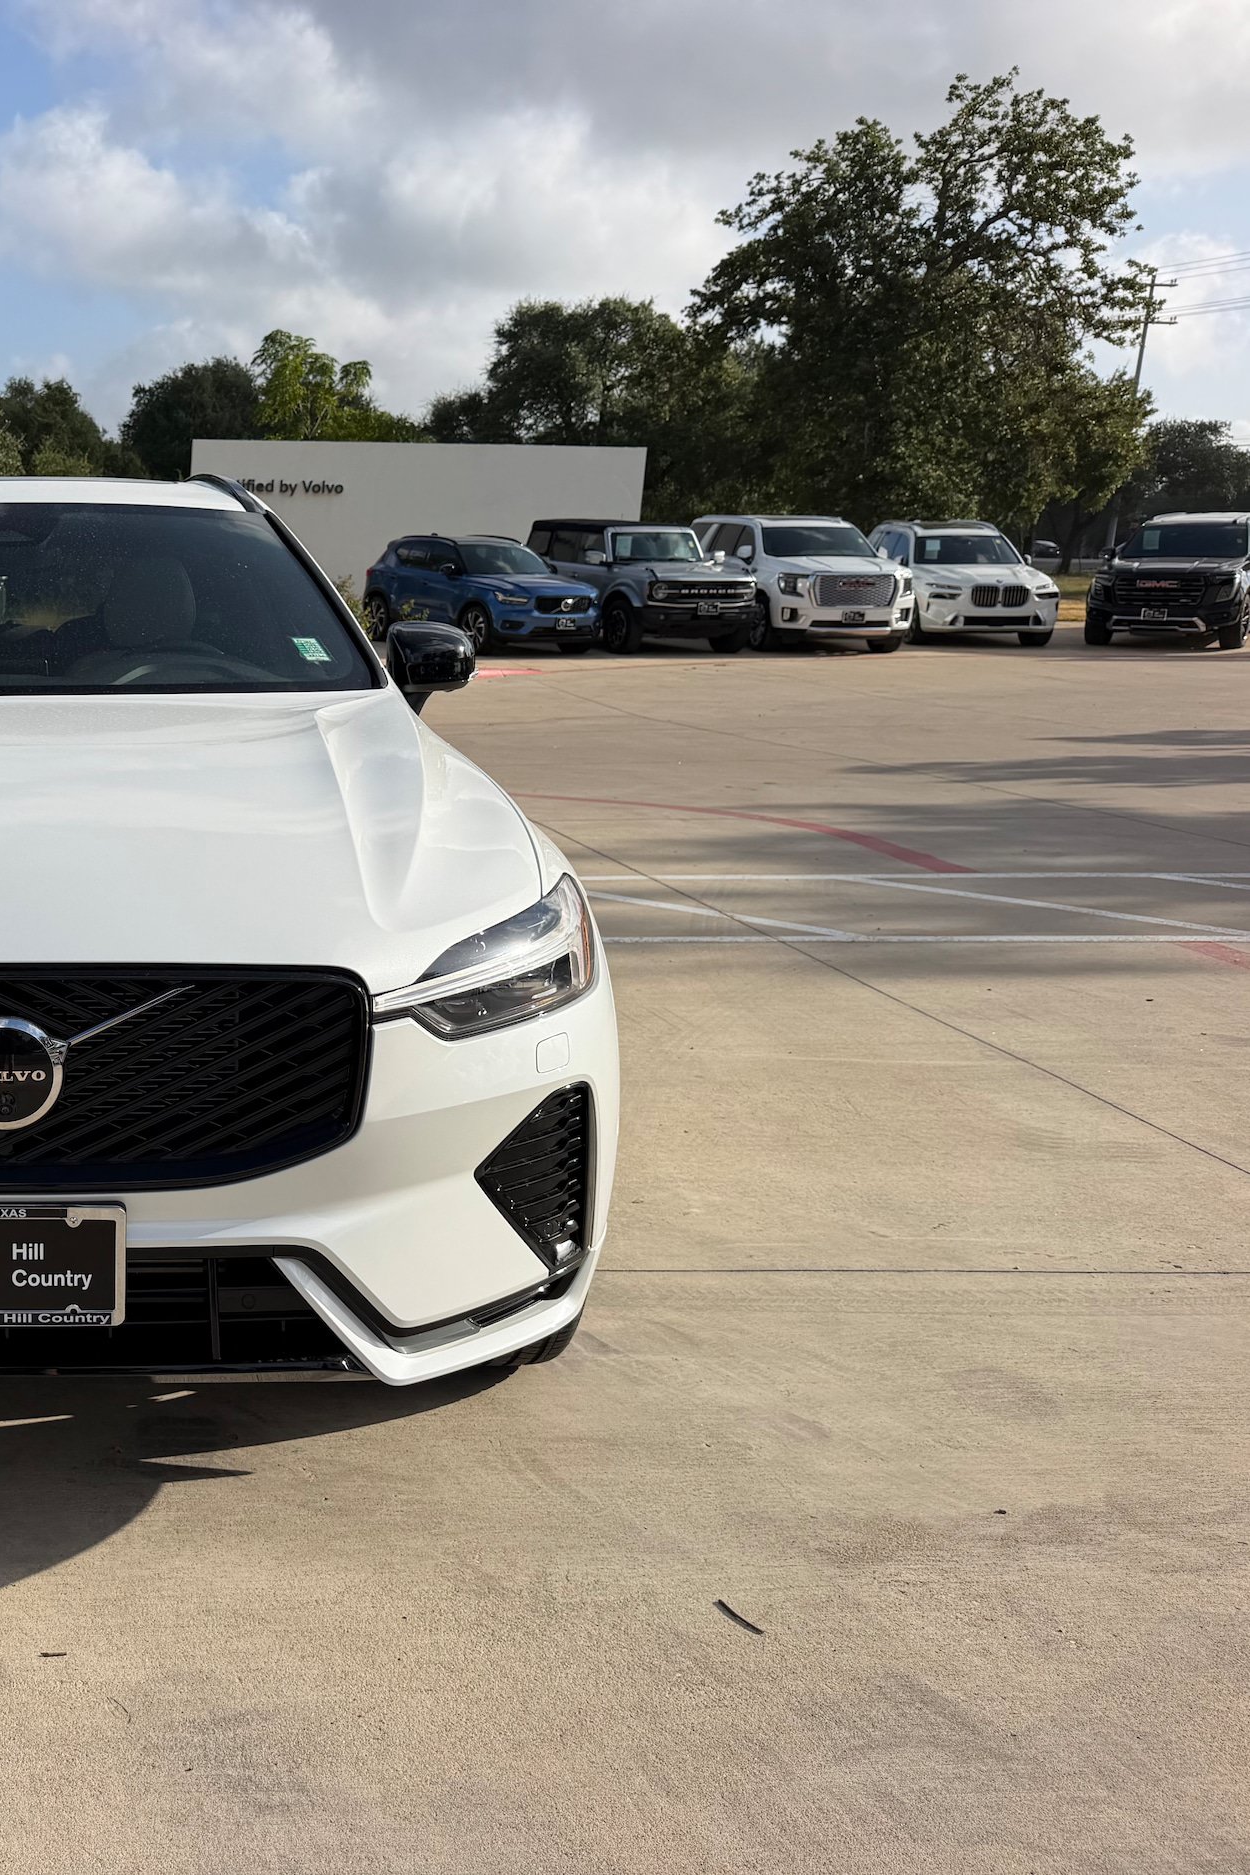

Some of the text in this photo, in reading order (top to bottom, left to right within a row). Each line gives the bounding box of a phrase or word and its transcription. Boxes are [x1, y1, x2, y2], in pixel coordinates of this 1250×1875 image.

[279, 480, 297, 496] by
[302, 481, 344, 494] Volvo
[12, 1243, 44, 1260] Hill
[11, 1269, 92, 1290] Country
[3, 1313, 32, 1323] Hill
[37, 1313, 110, 1325] Country
